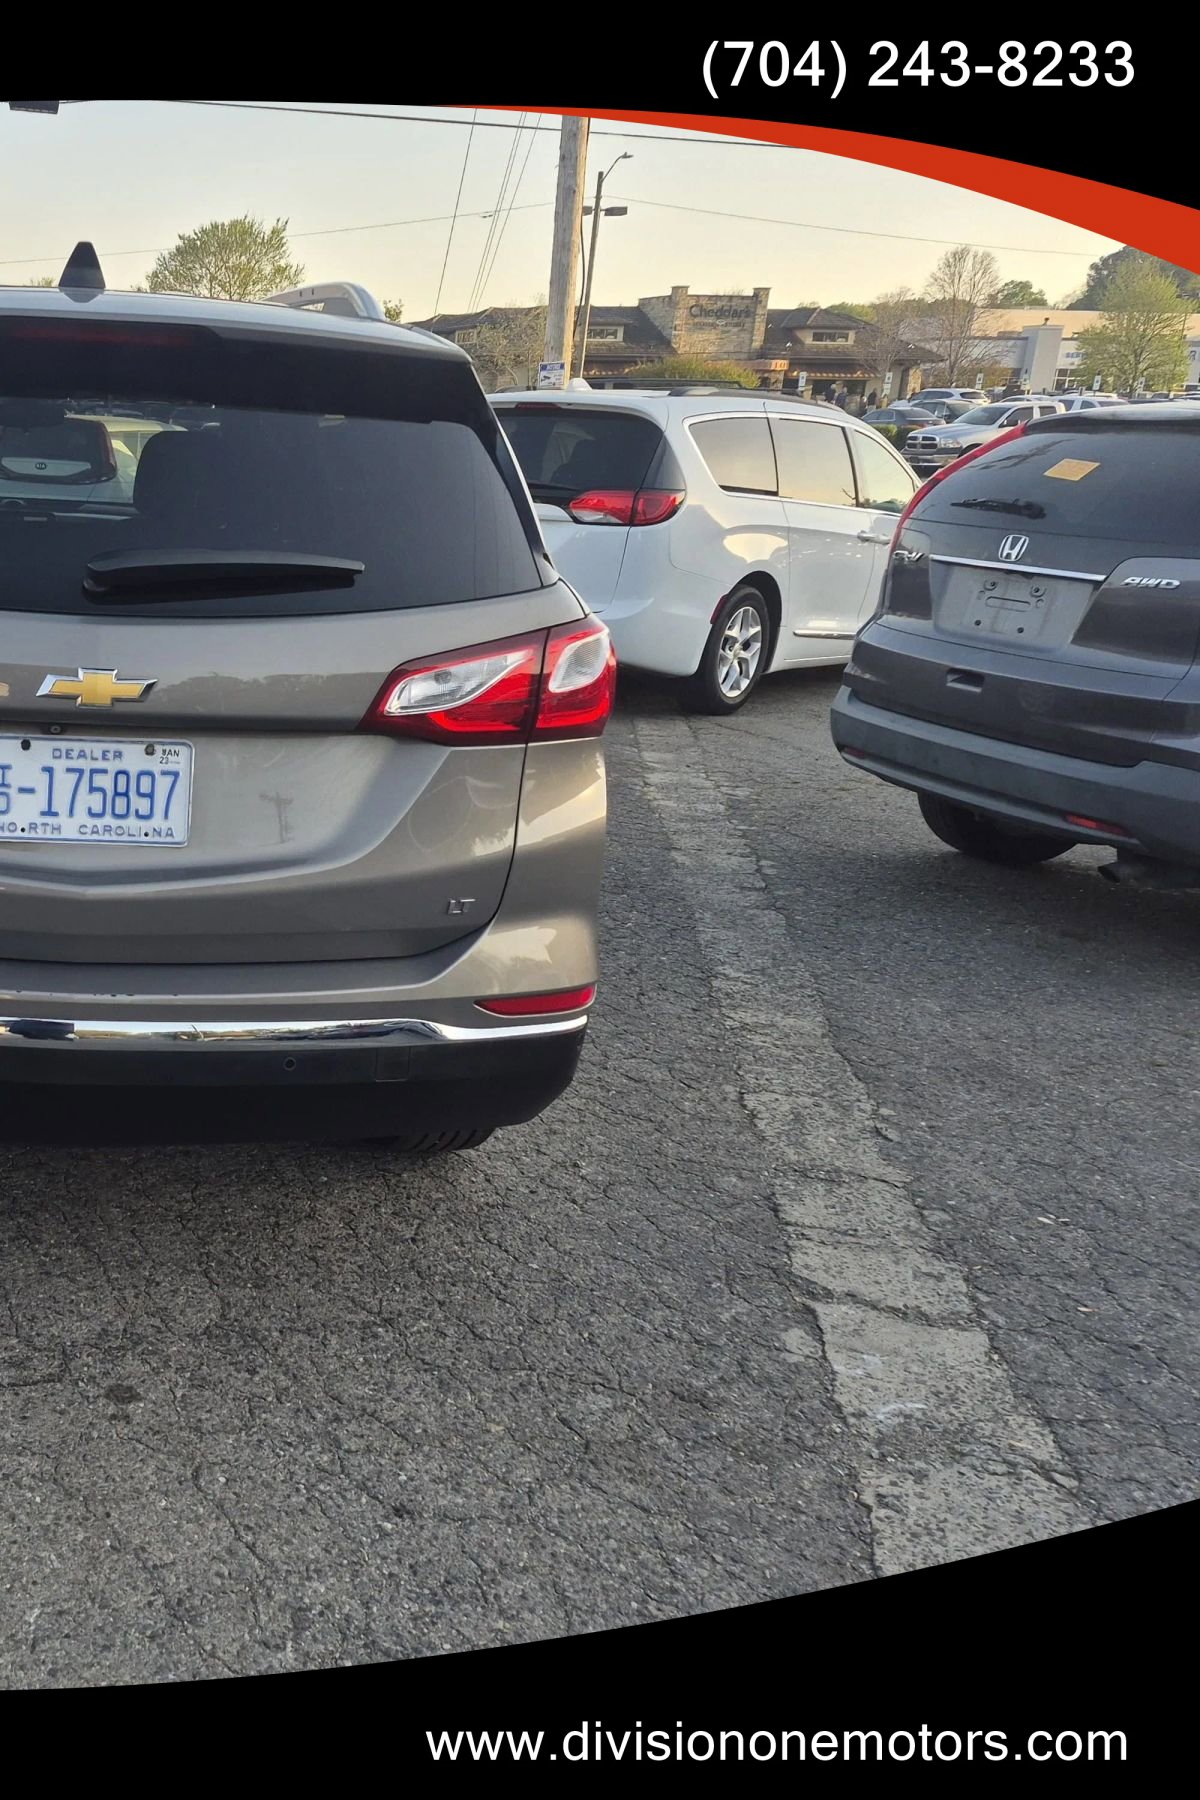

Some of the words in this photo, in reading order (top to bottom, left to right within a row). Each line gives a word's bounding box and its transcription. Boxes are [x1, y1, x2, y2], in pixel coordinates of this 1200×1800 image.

[1120, 576, 1181, 590] AWD
[52, 748, 123, 761] DEALER
[79, 824, 175, 839] CAROLINA
[448, 898, 476, 914] LT
